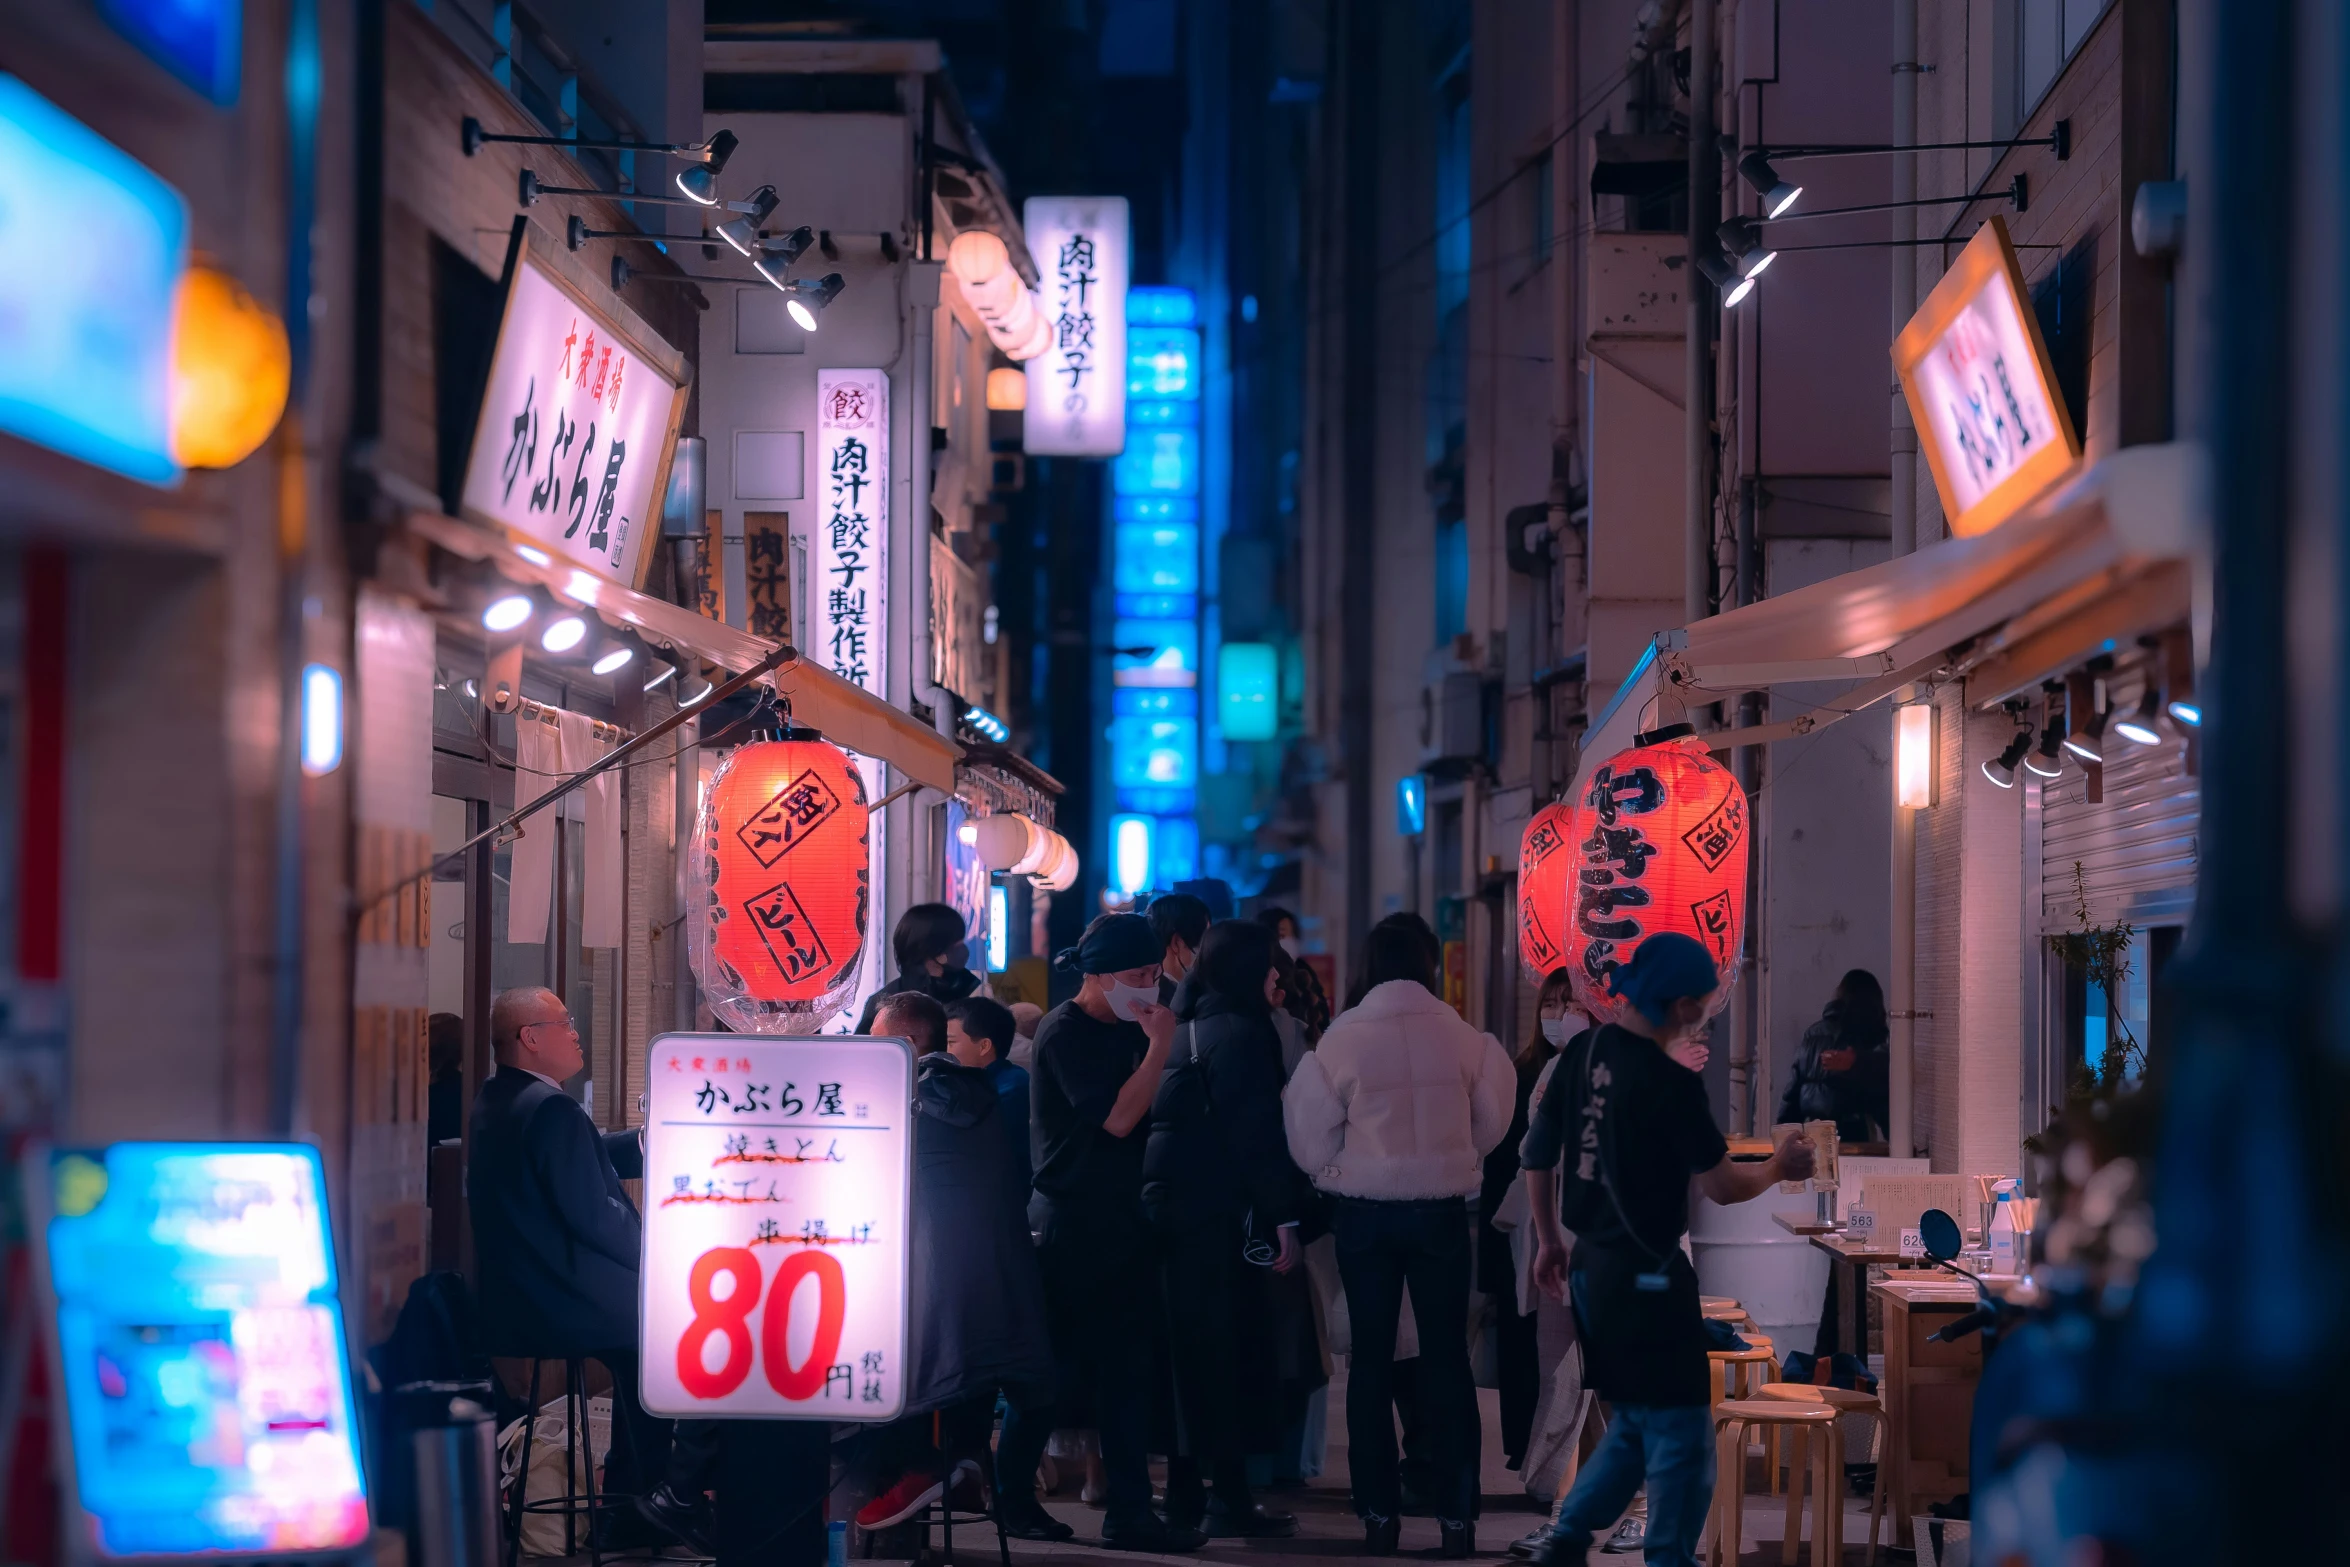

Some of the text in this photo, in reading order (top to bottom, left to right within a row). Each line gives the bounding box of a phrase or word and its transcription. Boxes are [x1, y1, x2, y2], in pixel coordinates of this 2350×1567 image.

[559, 318, 625, 414] 大衆酒場
[503, 374, 626, 553] かぶら屋
[755, 891, 817, 977] ビール
[667, 1056, 753, 1074] 大衆酒場
[695, 1080, 846, 1118] かぶら屋
[724, 1133, 844, 1162] 焼きとん
[758, 1218, 876, 1246] 串揚げ
[1851, 1215, 1873, 1227] 563
